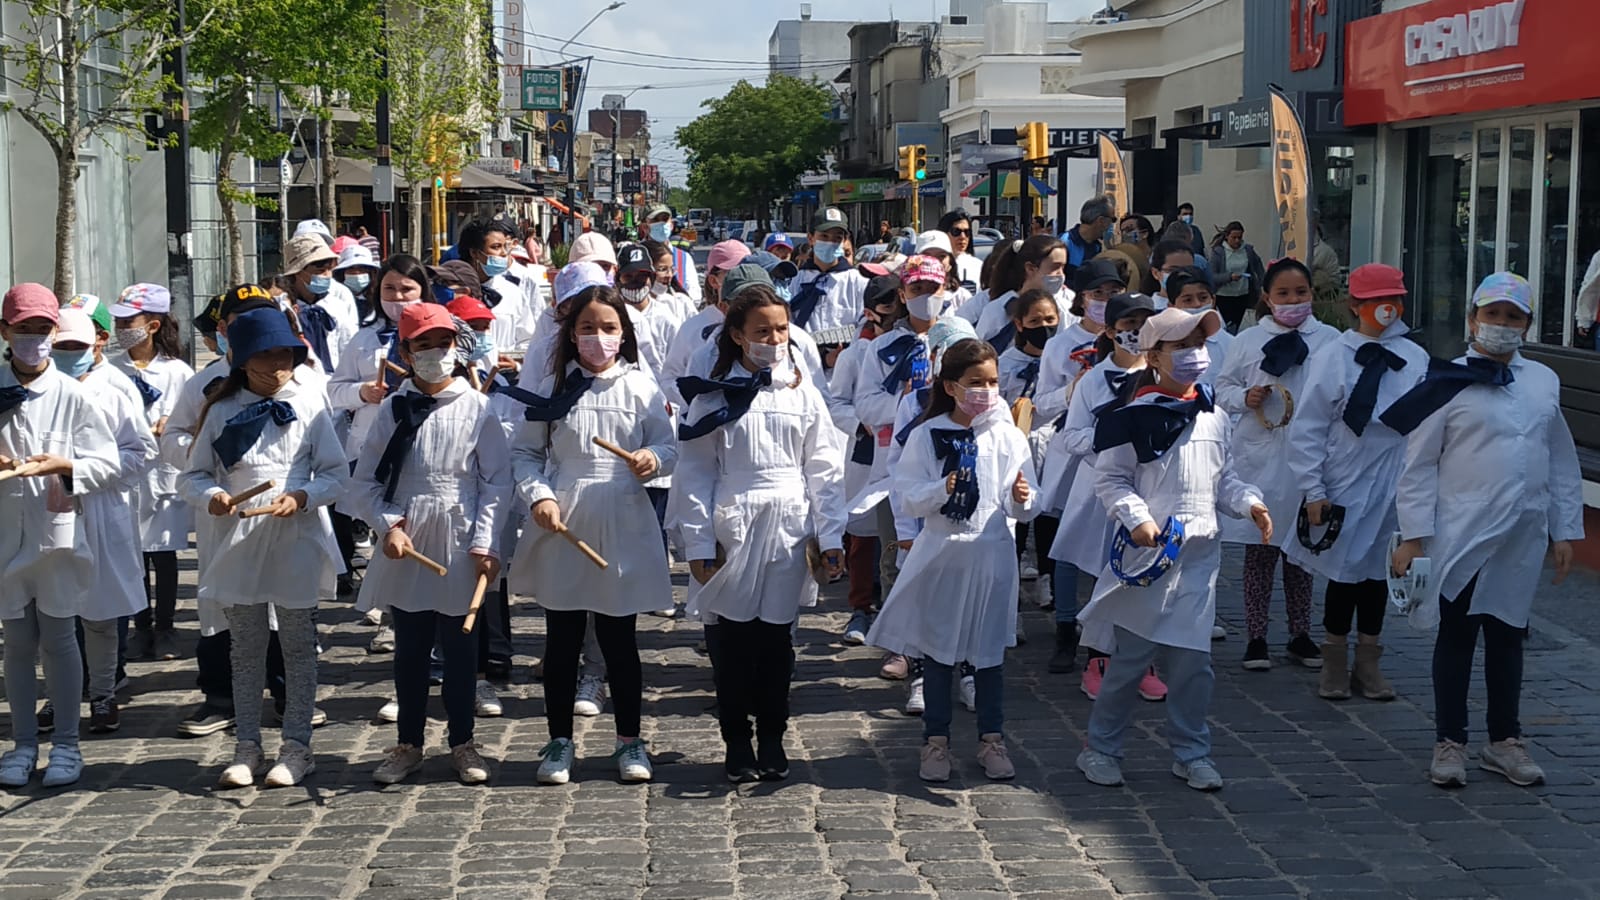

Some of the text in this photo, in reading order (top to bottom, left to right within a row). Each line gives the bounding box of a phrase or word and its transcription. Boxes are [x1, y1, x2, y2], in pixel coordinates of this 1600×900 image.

[526, 72, 558, 84] FOTOS
[526, 86, 535, 105] 1
[1228, 106, 1270, 136] Papelería
